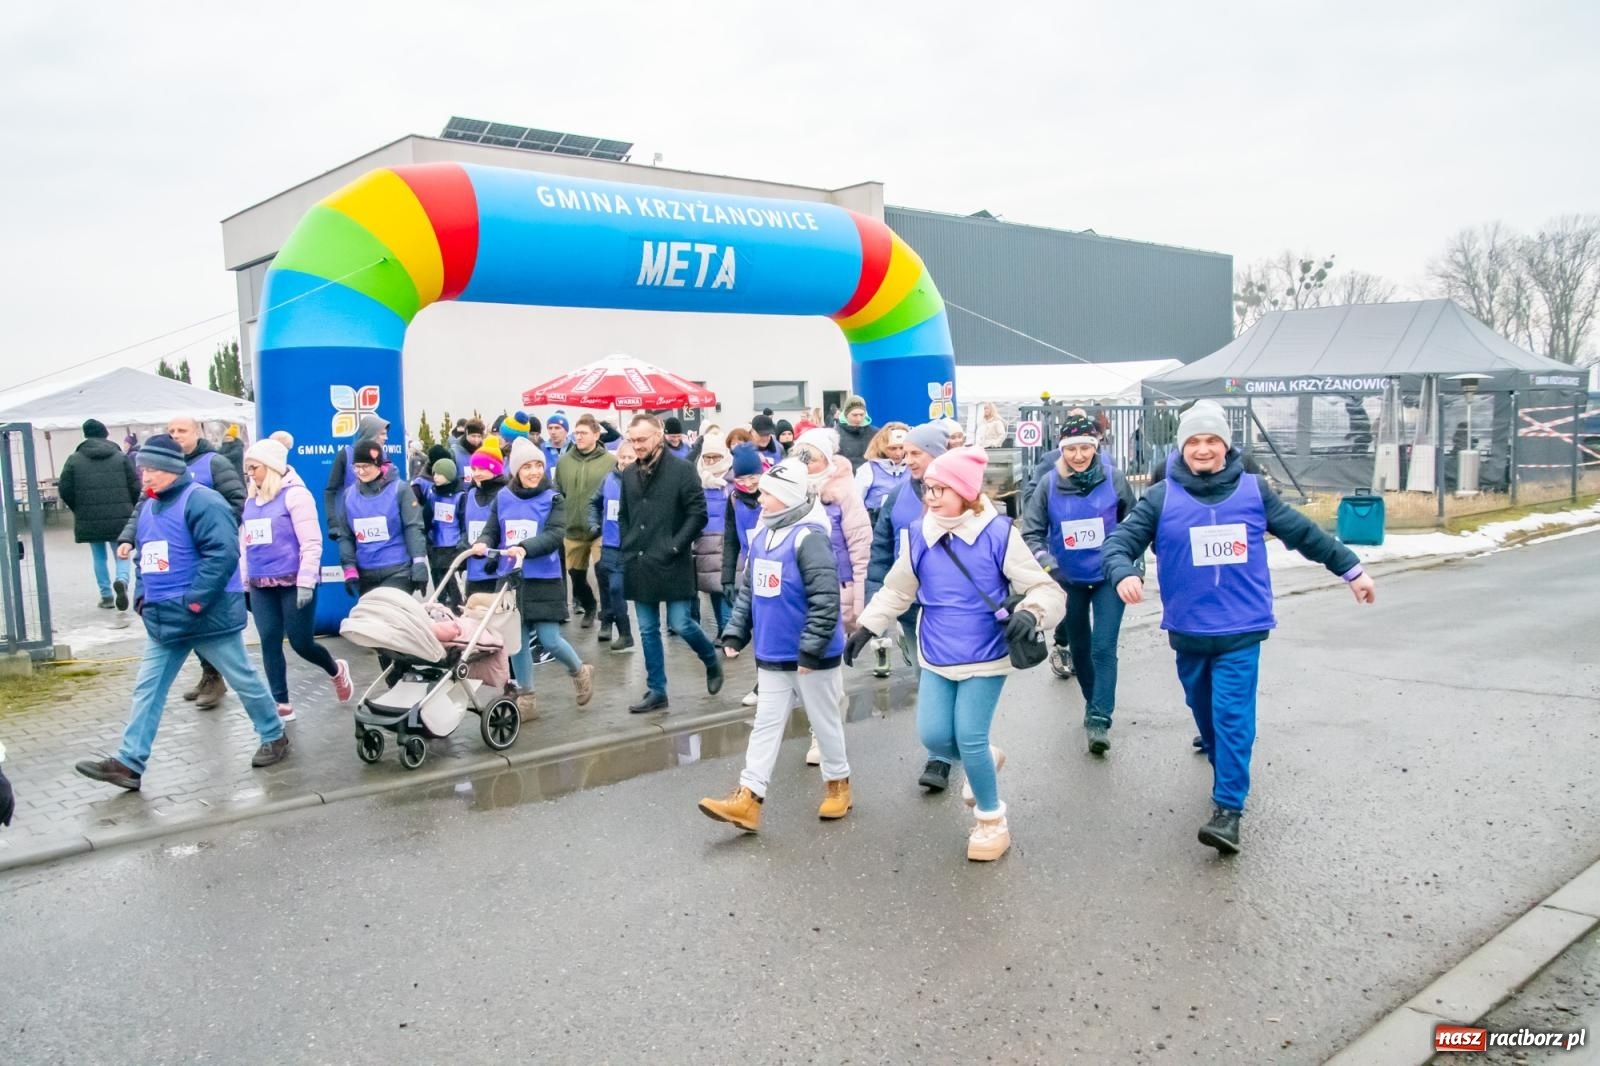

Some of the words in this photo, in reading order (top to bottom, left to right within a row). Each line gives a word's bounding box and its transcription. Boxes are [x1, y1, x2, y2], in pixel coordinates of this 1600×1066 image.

[536, 185, 633, 216] GMINA
[637, 196, 820, 231] KRZYŻANOWICE
[636, 240, 737, 290] META
[1245, 381, 1287, 393] GMINA
[616, 398, 642, 406] WARKA
[1023, 429, 1036, 440] 20
[298, 444, 335, 455] GMINA
[1074, 530, 1096, 543] 179
[1203, 541, 1233, 558] 108
[757, 573, 767, 588] 51
